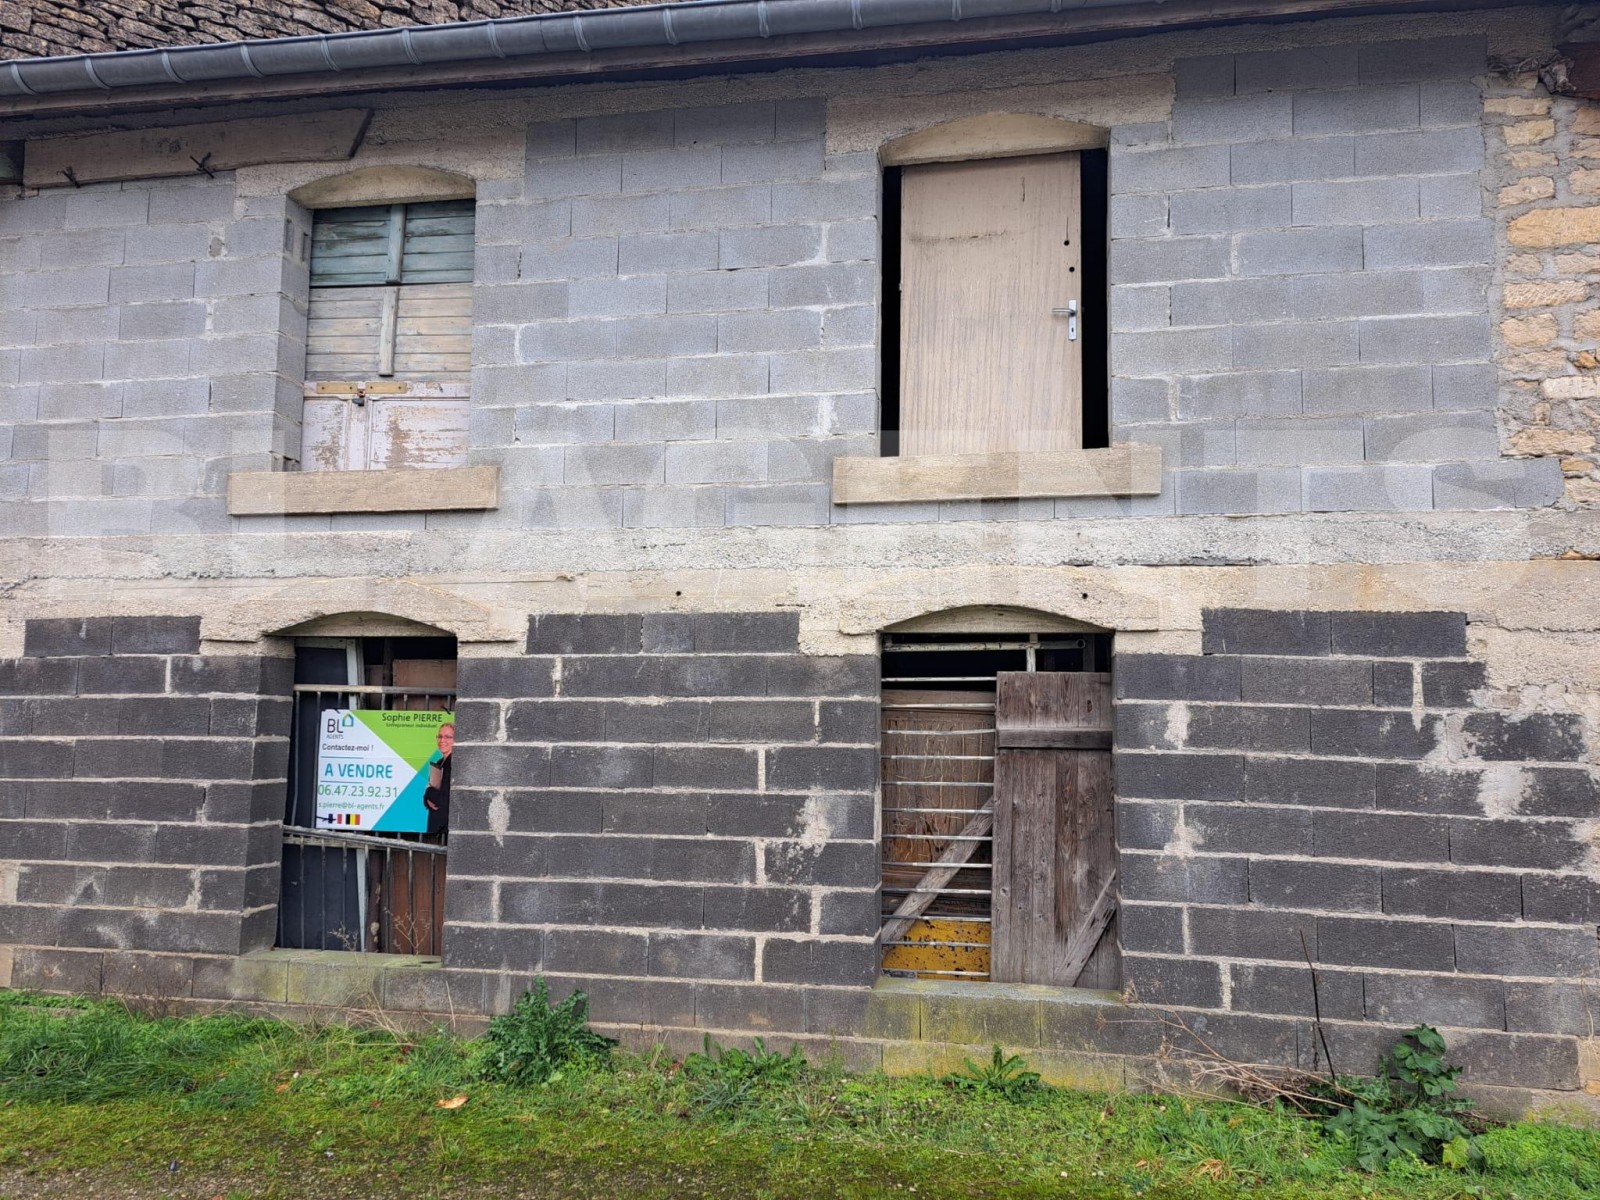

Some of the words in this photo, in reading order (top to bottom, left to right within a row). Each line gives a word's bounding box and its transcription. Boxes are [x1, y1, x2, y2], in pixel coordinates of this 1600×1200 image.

[382, 713, 410, 723] Sophie
[413, 713, 443, 722] PIERRE
[327, 718, 344, 733] BL
[322, 743, 370, 751] Contactez-moi
[324, 763, 334, 776] A
[338, 763, 393, 778] VENDRE
[318, 784, 397, 798] 06.47.23.92.31
[318, 801, 385, 810] s.pierre@bl-agents.fr
